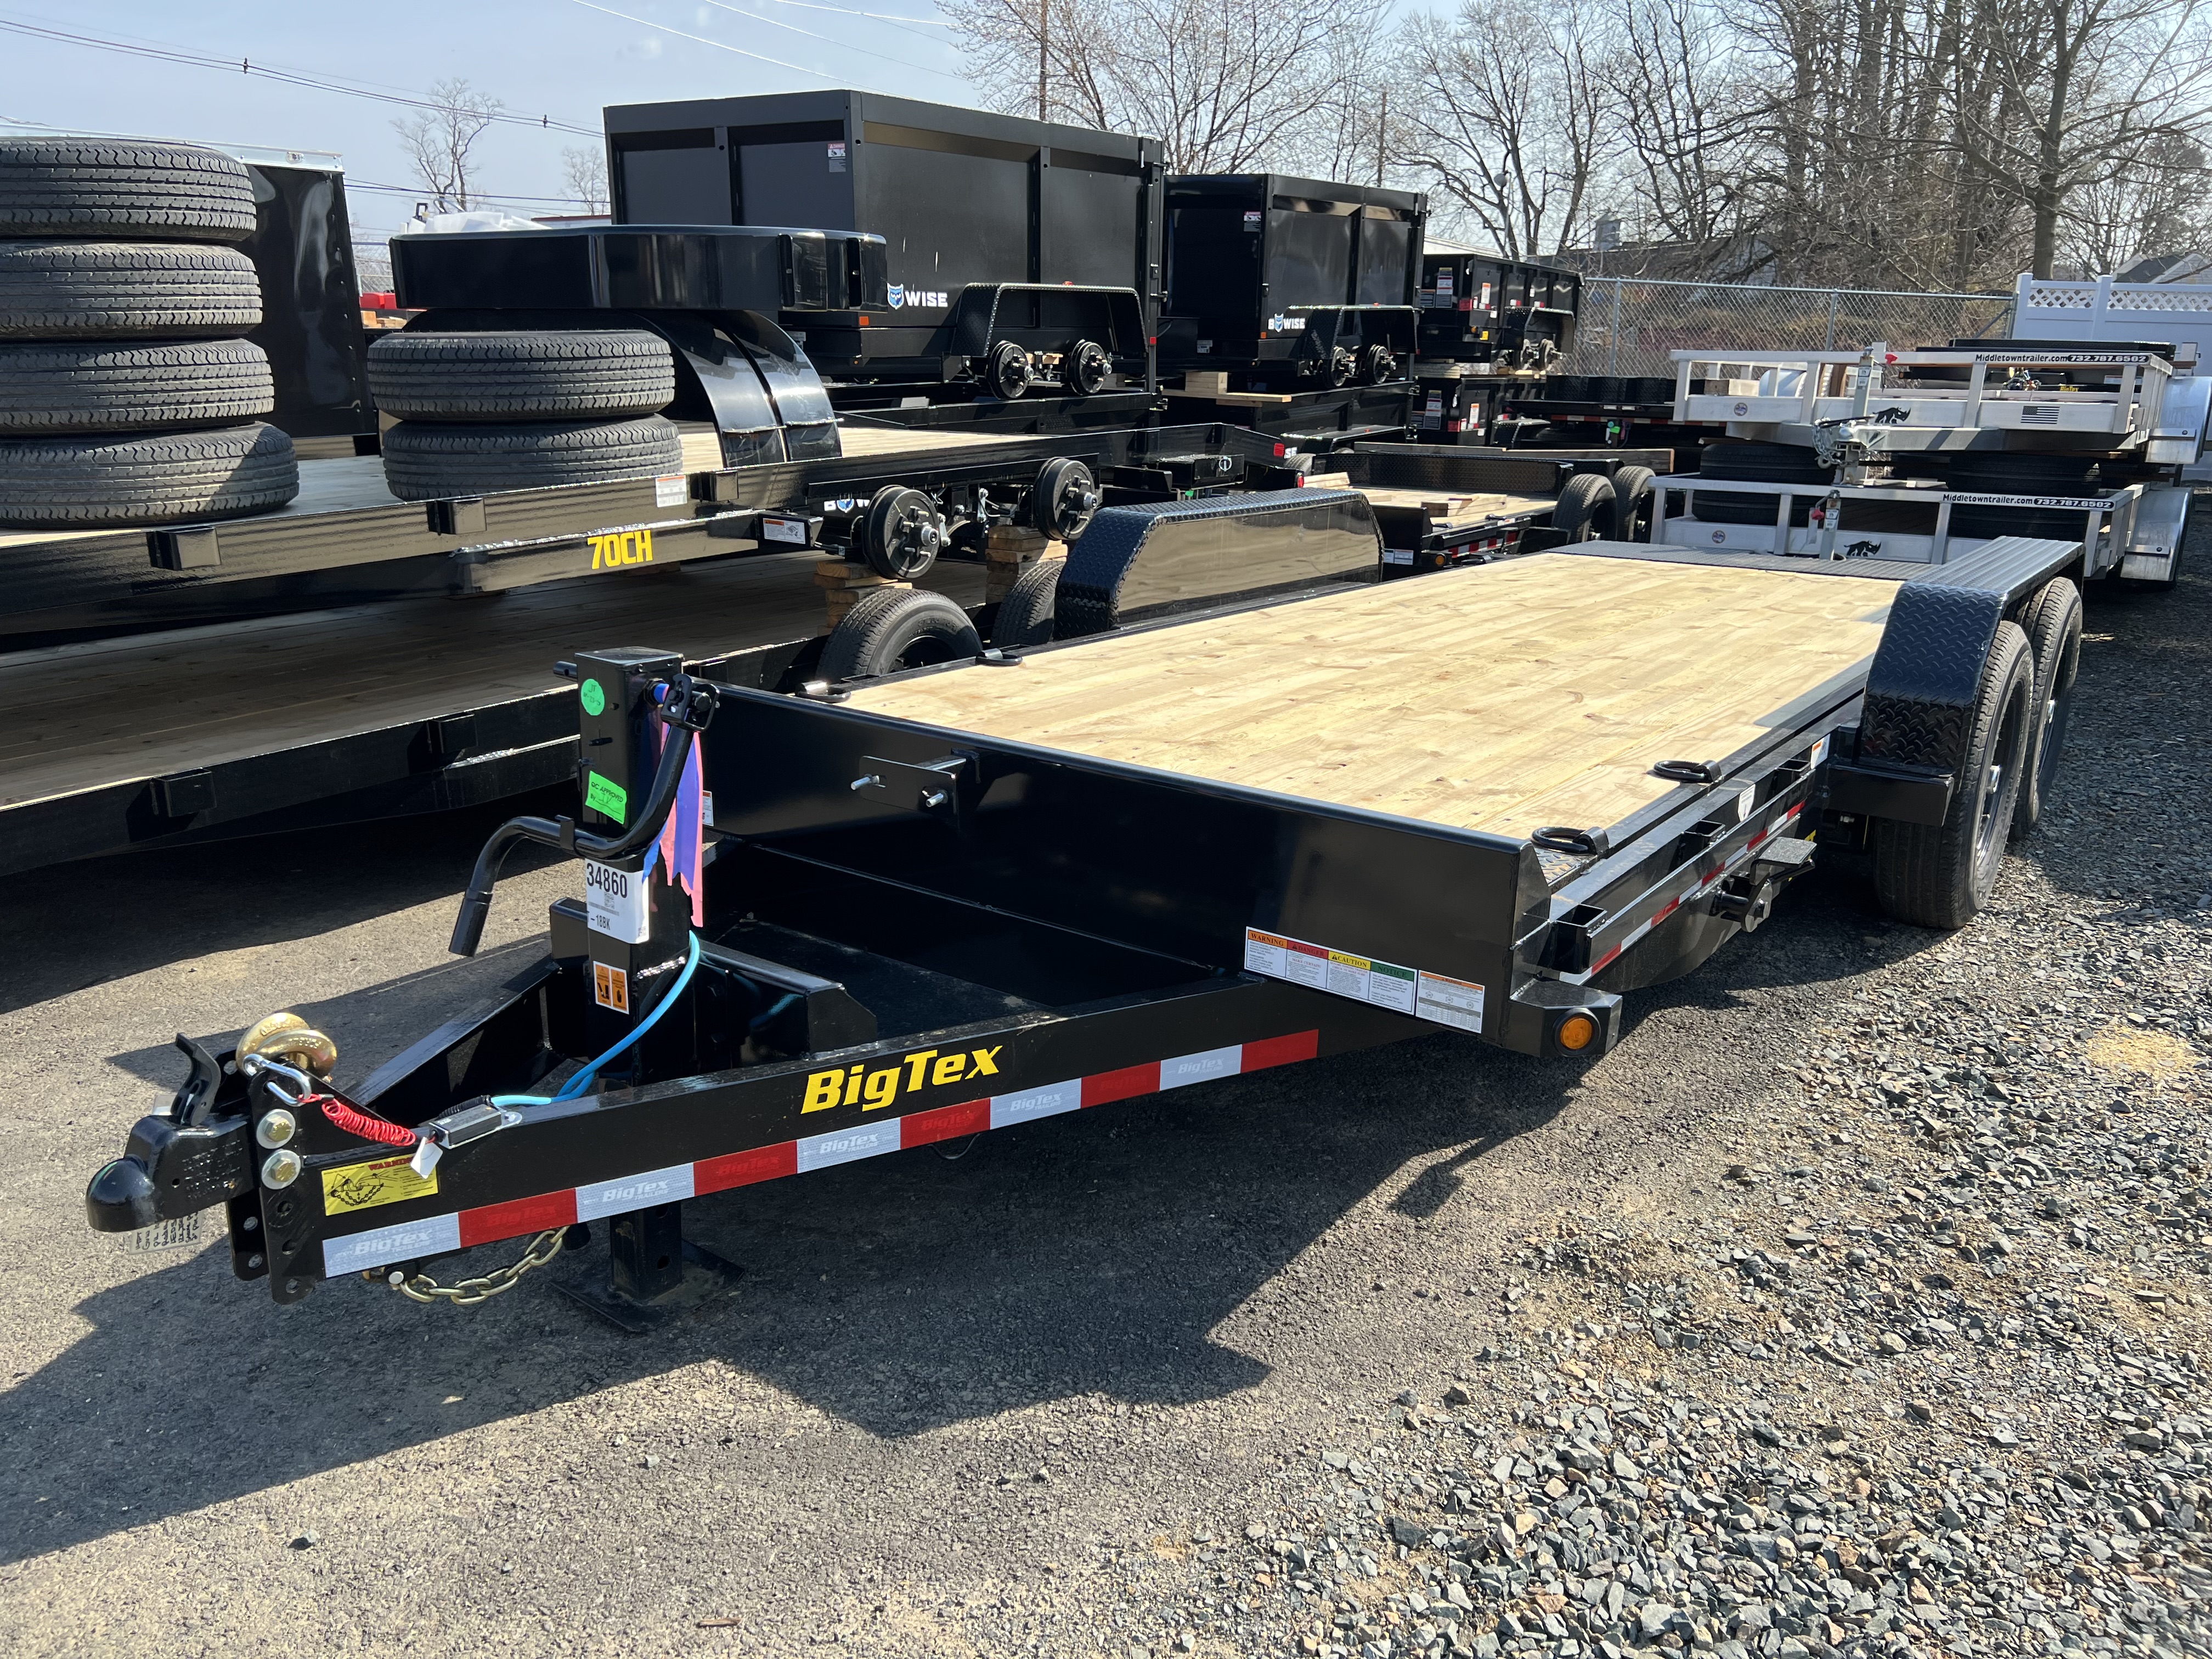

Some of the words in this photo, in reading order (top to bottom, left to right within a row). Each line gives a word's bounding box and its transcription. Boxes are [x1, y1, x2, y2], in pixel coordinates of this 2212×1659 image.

[1975, 354, 2068, 362] Middletowntrailer.com
[1943, 494, 2033, 504] Middletowntrailer.com
[2036, 499, 2112, 509] 732.787.6502
[587, 529, 653, 569] 70CH
[599, 785, 624, 803] APPROVED
[586, 862, 628, 899] 34860
[1251, 933, 1284, 947] WARNING
[1298, 944, 1324, 957] DANGER
[1338, 956, 1368, 968] CAUTION
[1378, 966, 1407, 978] NOTICE
[800, 1045, 1003, 1115] BigTex
[368, 1156, 414, 1171] WARNIN
